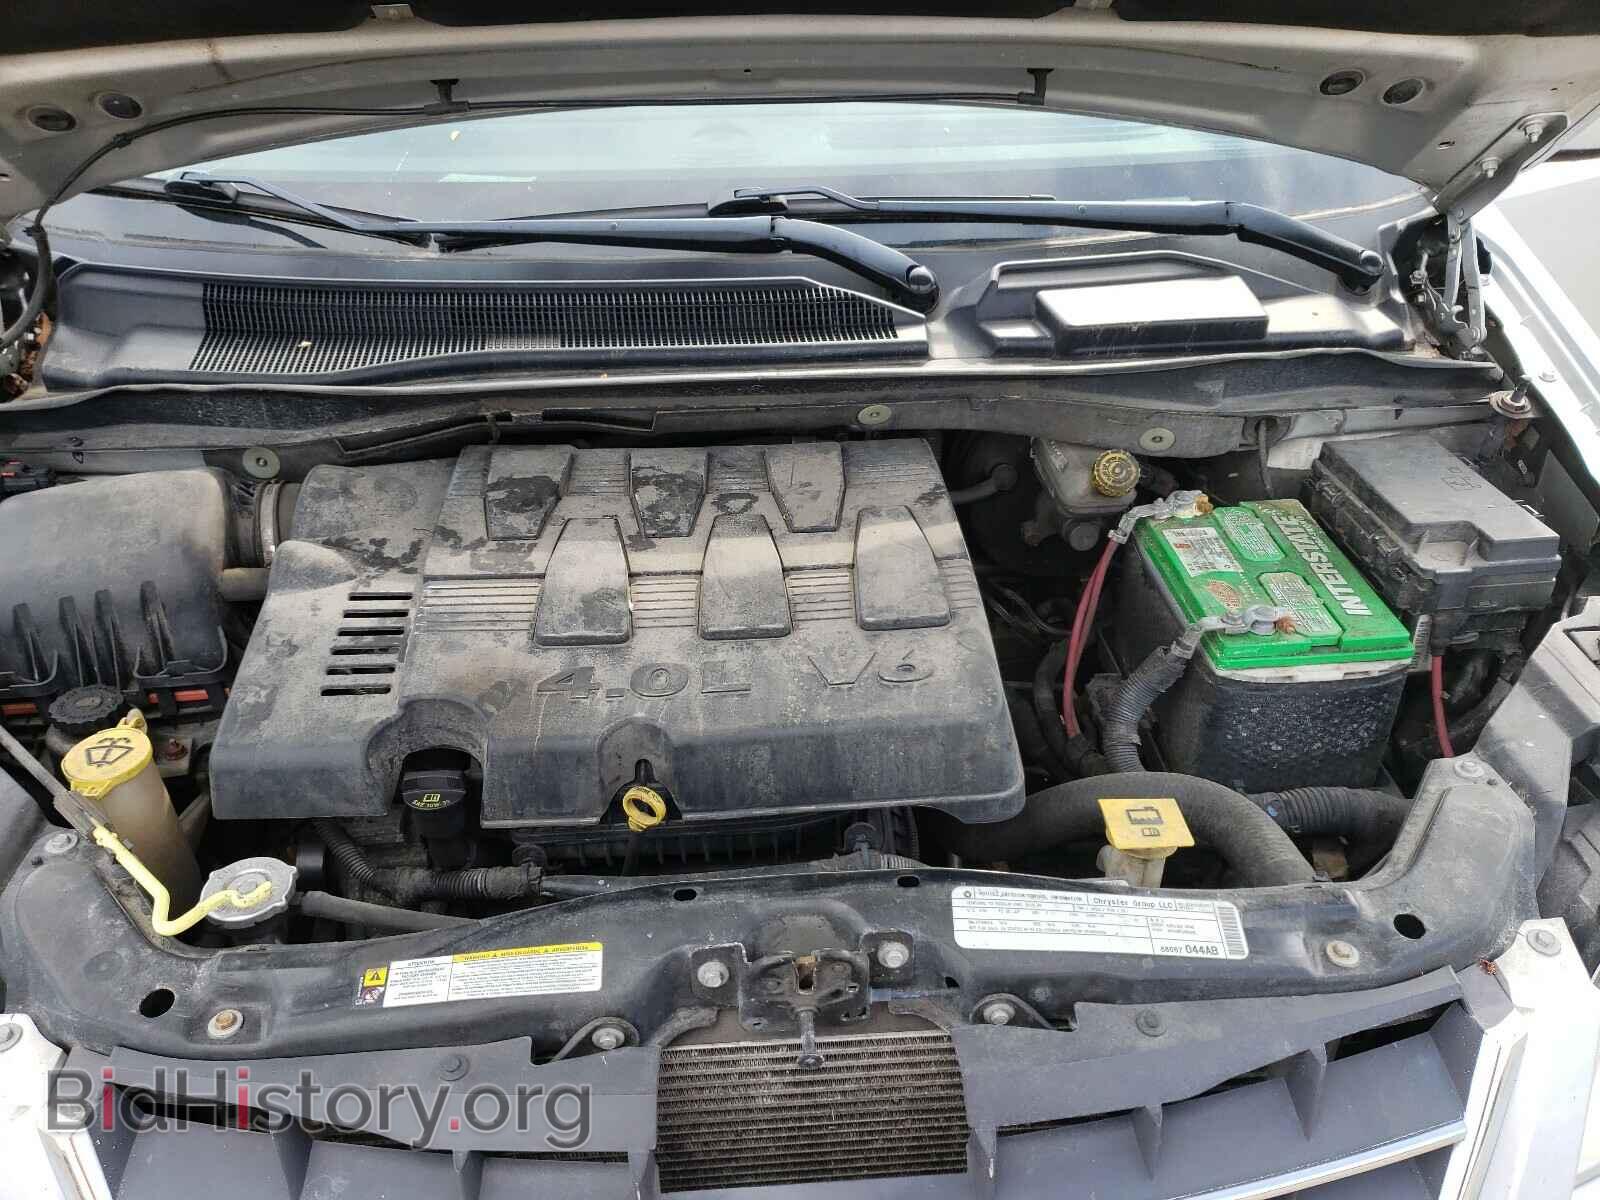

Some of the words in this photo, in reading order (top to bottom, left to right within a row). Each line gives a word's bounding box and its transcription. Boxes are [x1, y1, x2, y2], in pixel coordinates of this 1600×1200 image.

[1270, 511, 1373, 617] INTERSTATE
[536, 661, 752, 699] 4.0L
[806, 649, 933, 687] V6
[1092, 896, 1129, 908] Chrysler
[1132, 898, 1157, 909] Group
[1157, 900, 1175, 910] LLC
[1184, 945, 1220, 957] 044AB
